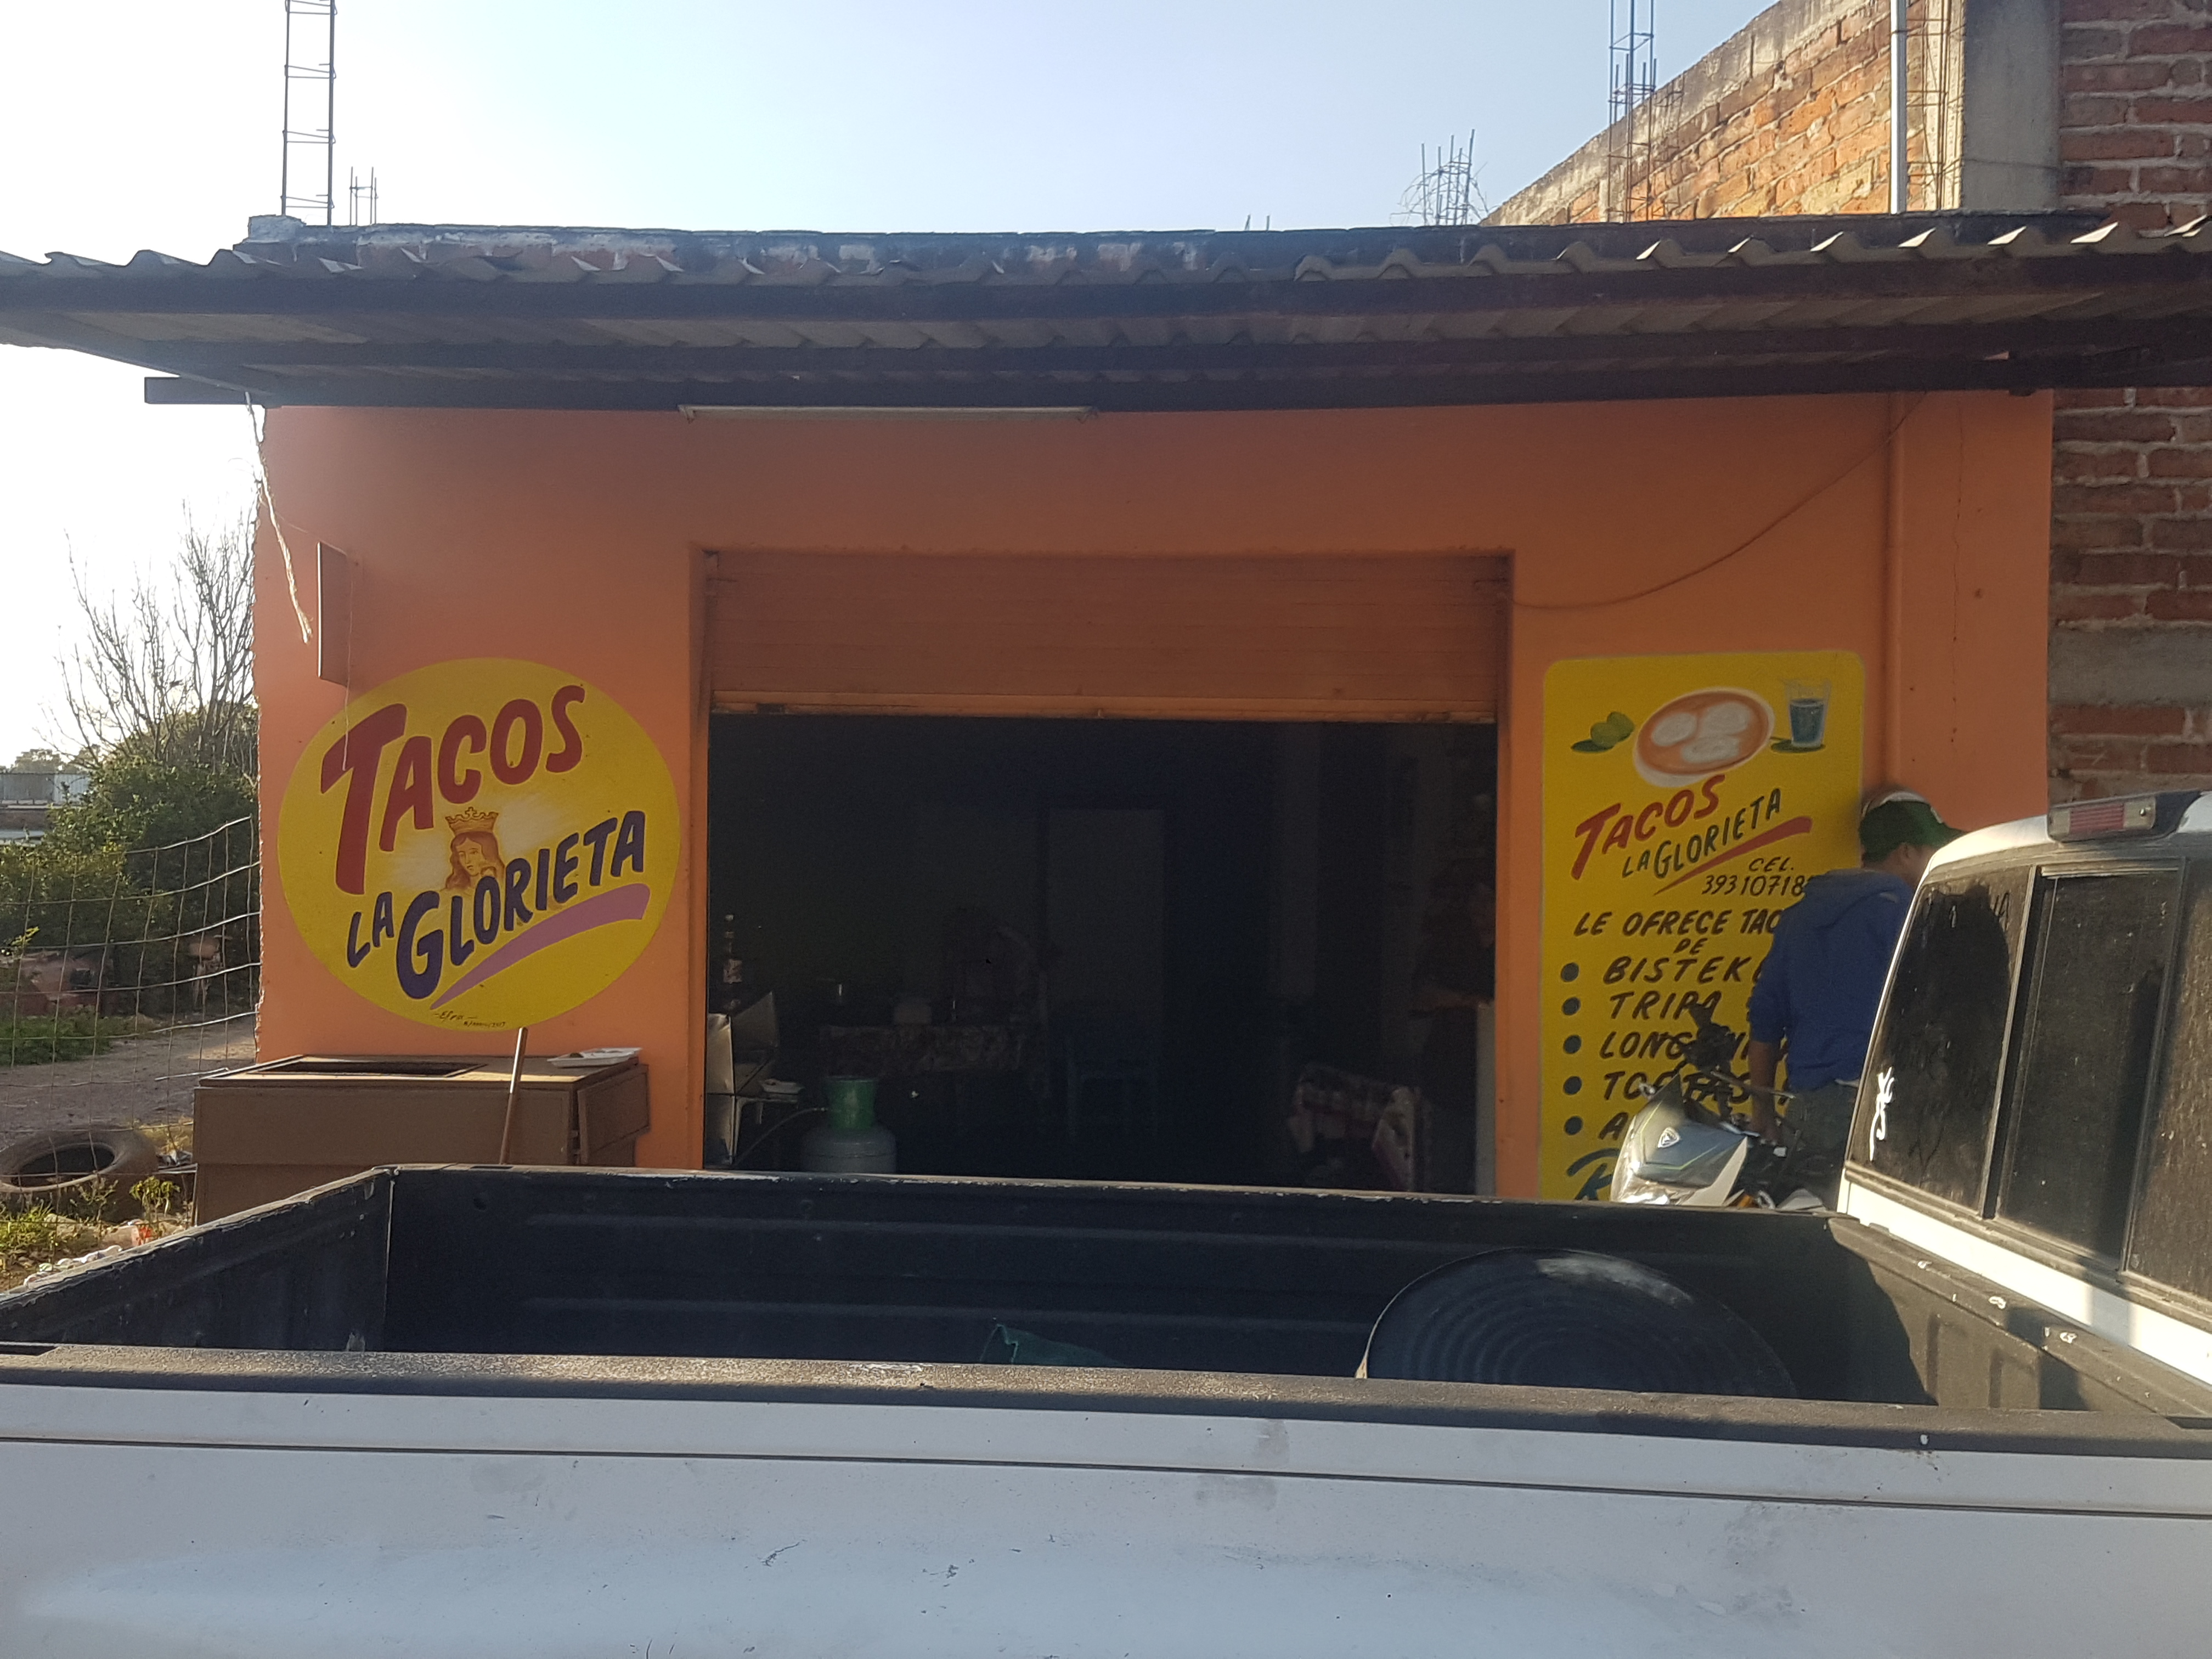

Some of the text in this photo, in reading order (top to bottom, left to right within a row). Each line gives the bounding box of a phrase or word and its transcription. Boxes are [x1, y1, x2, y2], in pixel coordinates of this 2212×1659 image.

[320, 685, 585, 894] TACOS
[1571, 774, 1725, 880] TACOS
[1622, 788, 1781, 878] LA GLORIETA
[1702, 874, 1806, 896] 39310718
[1748, 857, 1794, 872] CEL.
[347, 810, 646, 1000] LA GLORIETA
[1573, 909, 1783, 936] LE OFRECE TAC
[1673, 938, 1708, 955] DE
